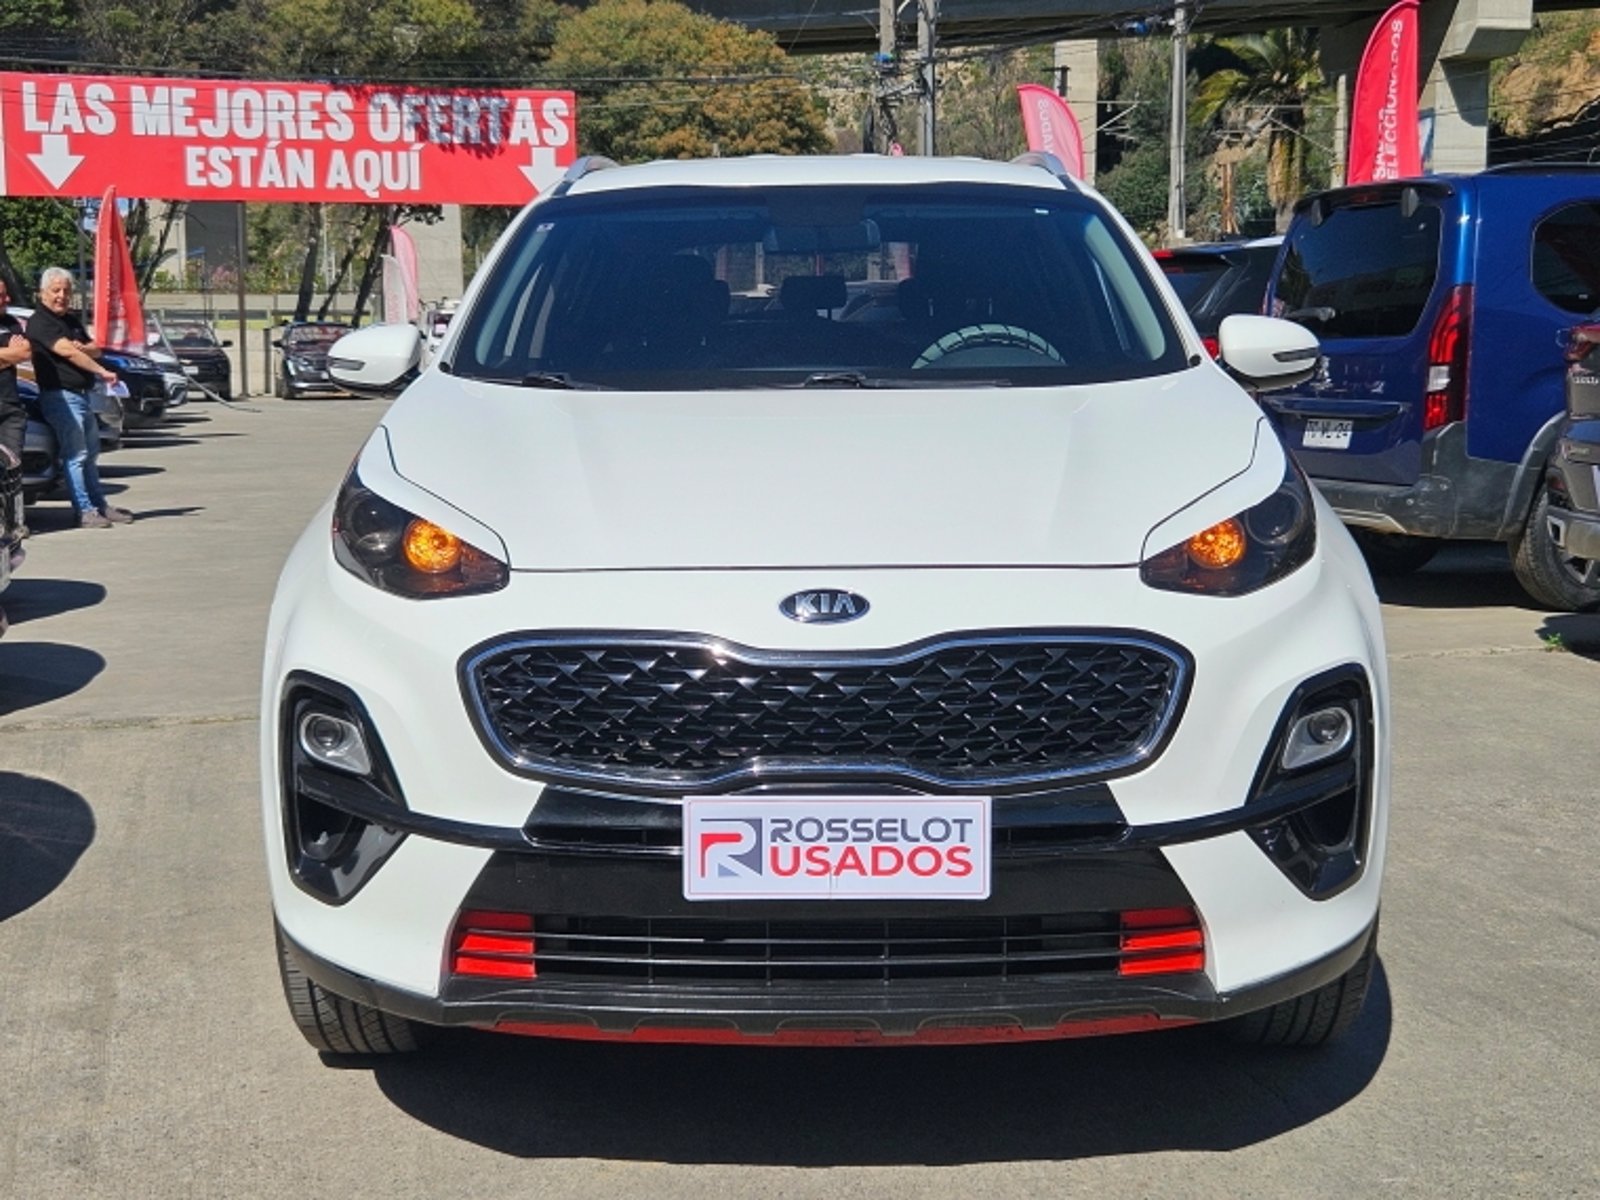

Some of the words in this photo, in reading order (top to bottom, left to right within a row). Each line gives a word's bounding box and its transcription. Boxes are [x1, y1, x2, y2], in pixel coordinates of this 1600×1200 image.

[22, 81, 116, 135] LAS
[130, 85, 354, 142] MEJORES
[367, 92, 570, 146] OFERTAS
[186, 140, 315, 188] ESTÁN
[325, 143, 426, 198] AQUÍ
[795, 593, 856, 614] KIA
[770, 817, 974, 843] ROSSELOT
[770, 845, 974, 878] USADOS
